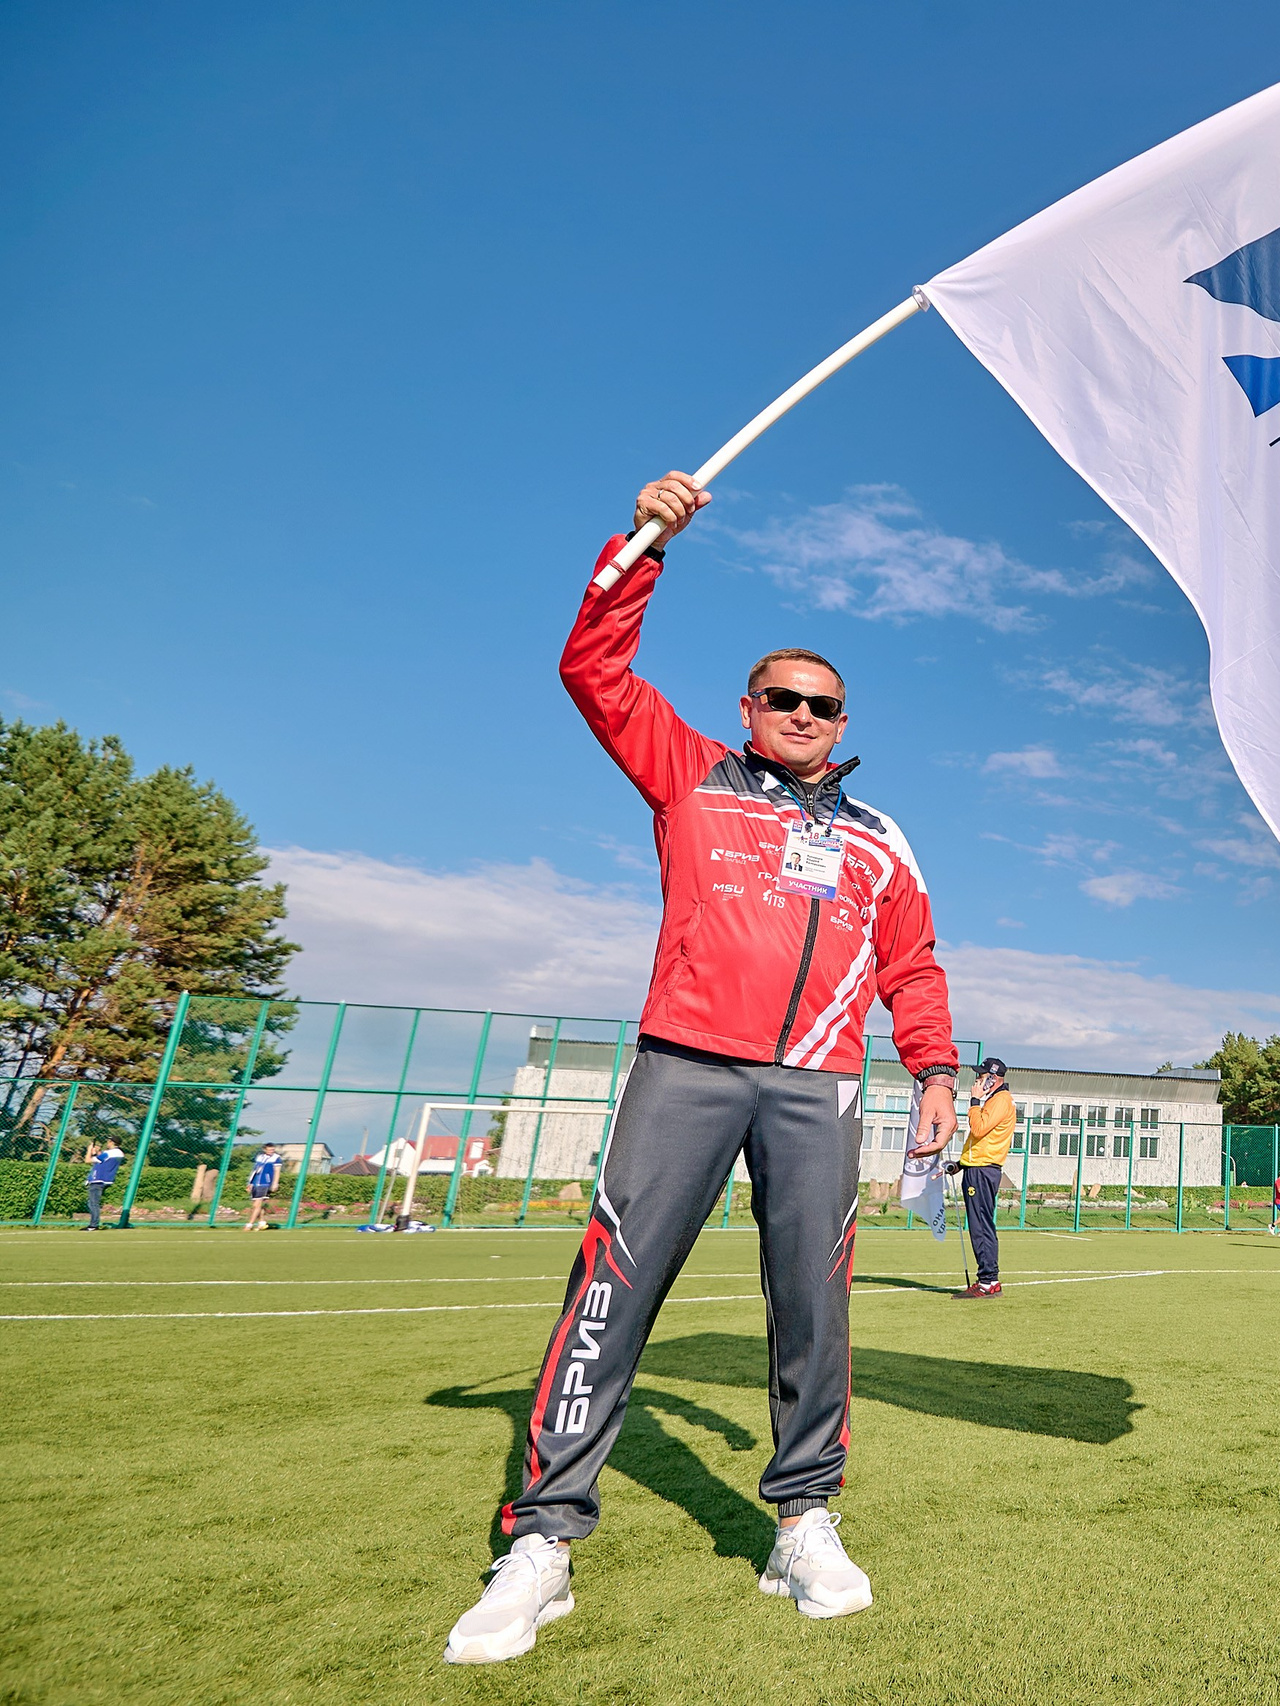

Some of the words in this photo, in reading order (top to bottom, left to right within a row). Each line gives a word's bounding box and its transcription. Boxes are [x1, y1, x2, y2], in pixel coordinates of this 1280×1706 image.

[758, 841, 784, 852] БРИ
[724, 850, 760, 862] БРИЗ
[757, 871, 780, 884] ГРА
[712, 883, 745, 895] MSU
[788, 880, 828, 895] УЧАСТНИК
[554, 1280, 614, 1435] БРИЗ
